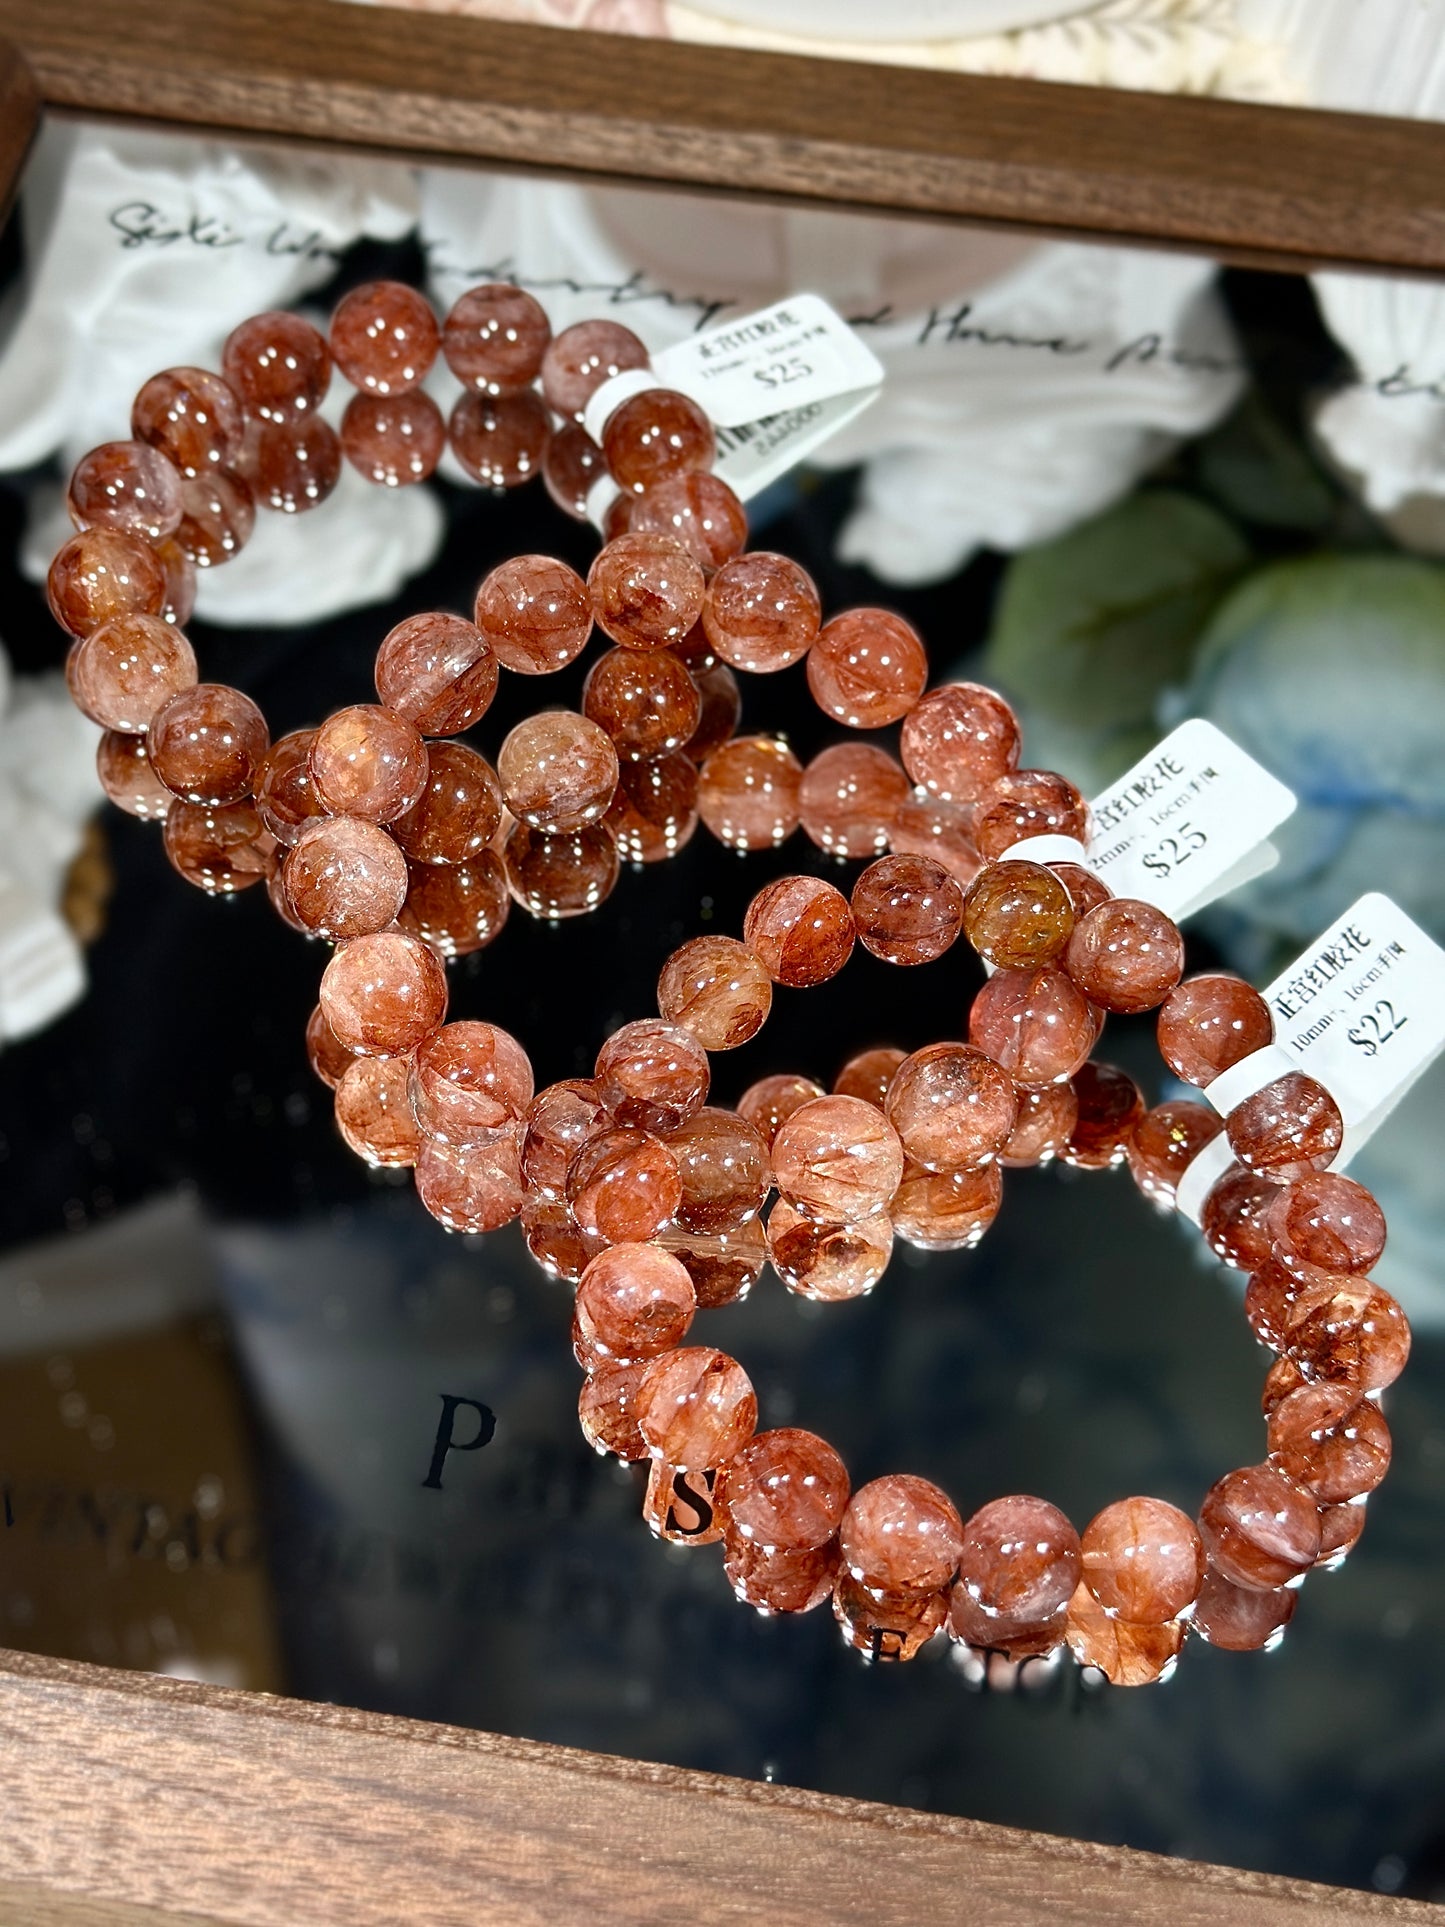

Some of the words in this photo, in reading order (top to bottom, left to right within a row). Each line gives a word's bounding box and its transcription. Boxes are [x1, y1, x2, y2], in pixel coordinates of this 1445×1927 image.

[753, 357, 813, 390] $25
[1092, 754, 1184, 841] 宫红胶花
[1142, 822, 1208, 879] $25
[1272, 924, 1371, 1022] 正宫红胶花
[1347, 999, 1408, 1057] $22
